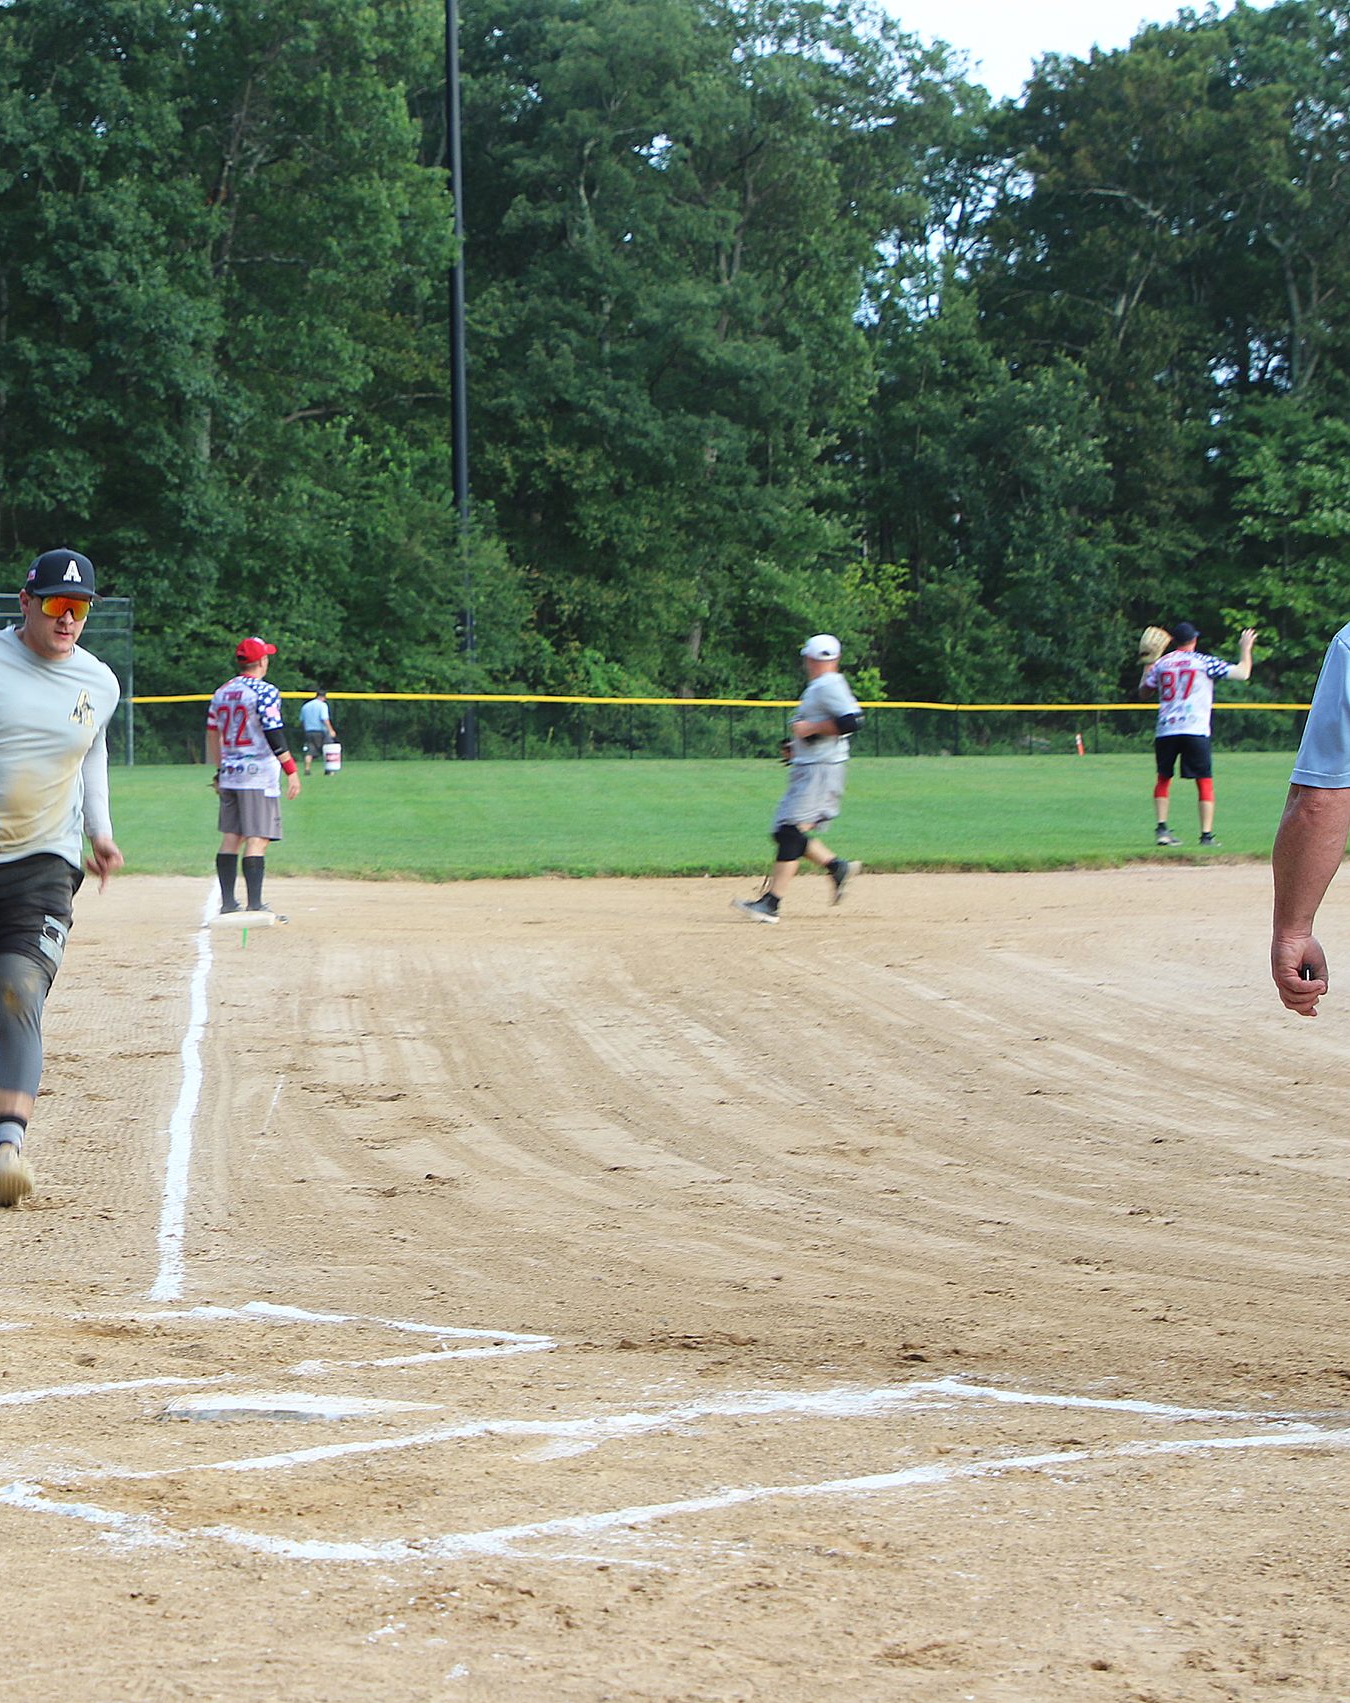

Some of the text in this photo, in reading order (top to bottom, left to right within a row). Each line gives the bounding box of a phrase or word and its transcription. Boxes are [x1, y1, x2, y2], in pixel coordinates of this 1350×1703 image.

[63, 559, 82, 583] A
[1160, 669, 1196, 702] 87
[217, 704, 253, 747] 22
